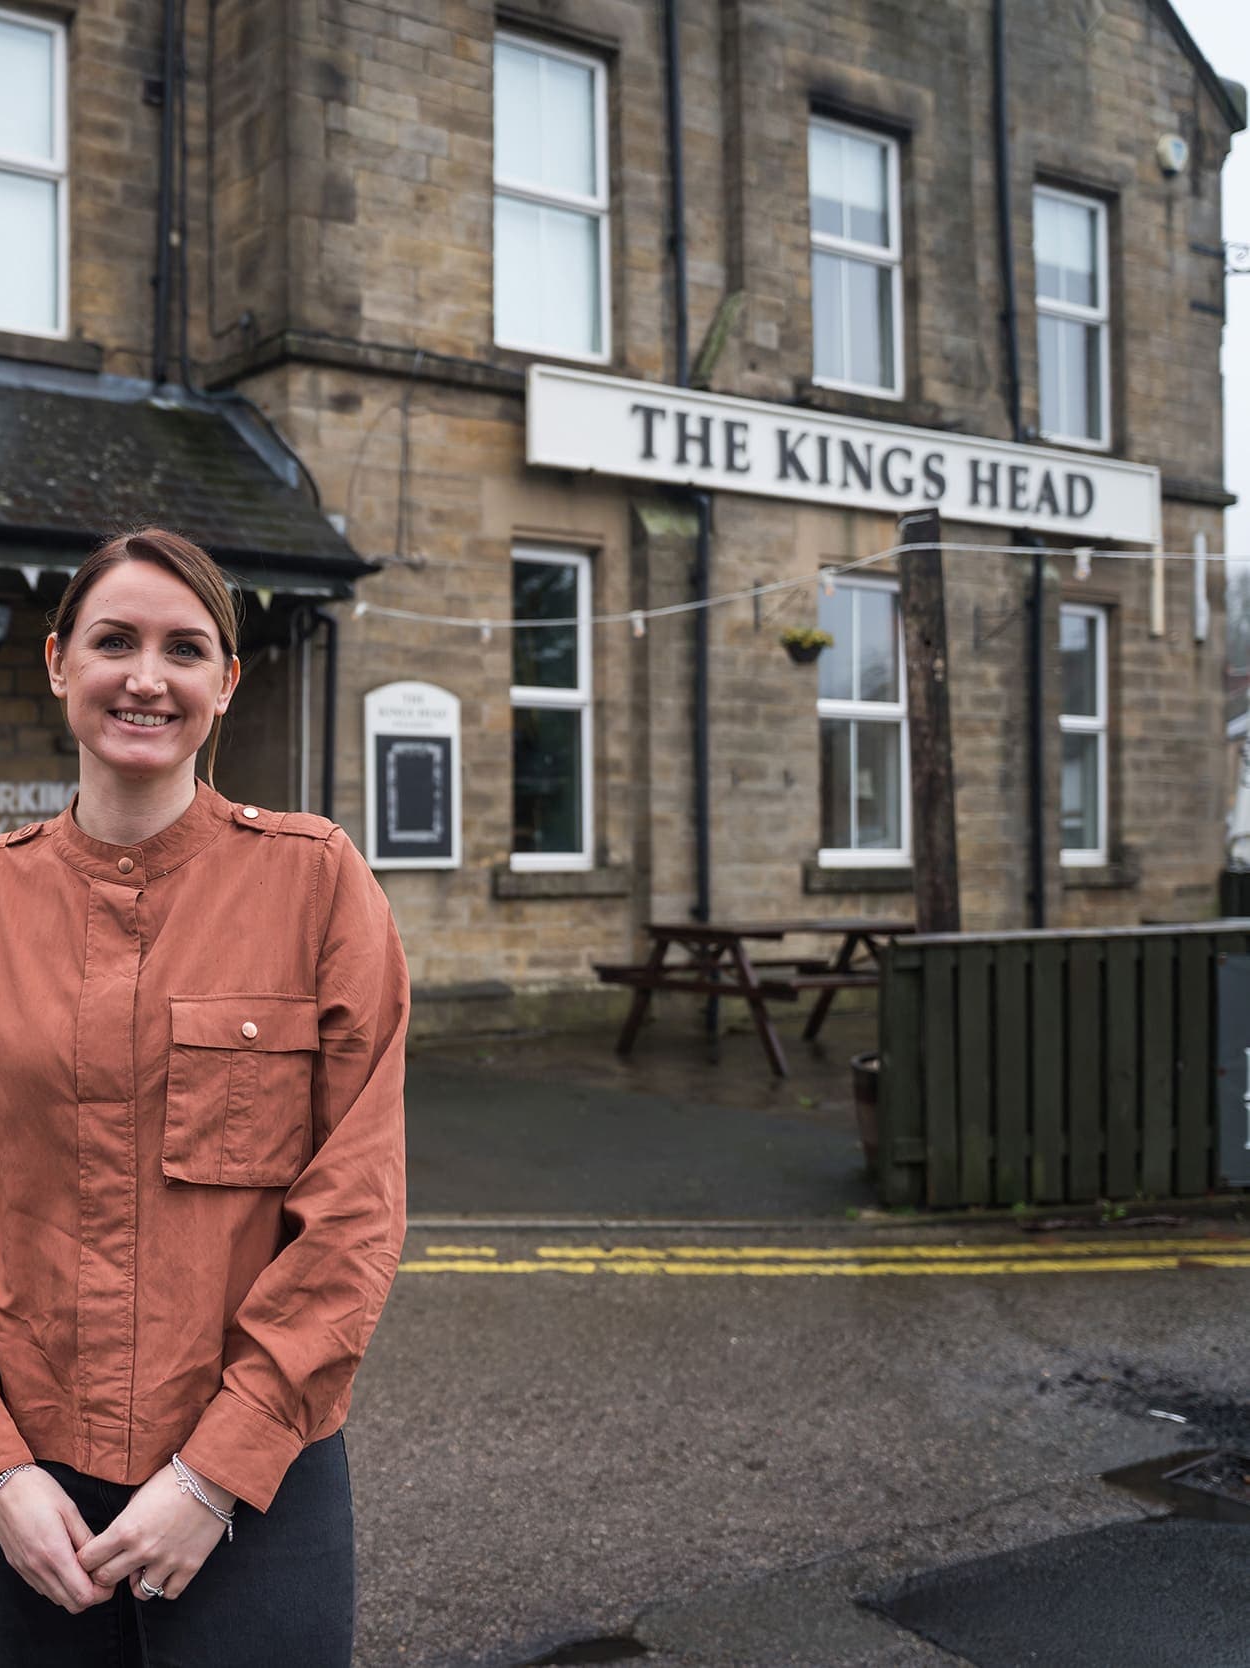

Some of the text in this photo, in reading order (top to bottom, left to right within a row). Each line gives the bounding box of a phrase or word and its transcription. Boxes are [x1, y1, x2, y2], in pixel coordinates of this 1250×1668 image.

[630, 403, 1094, 519] THE KINGS HEAD
